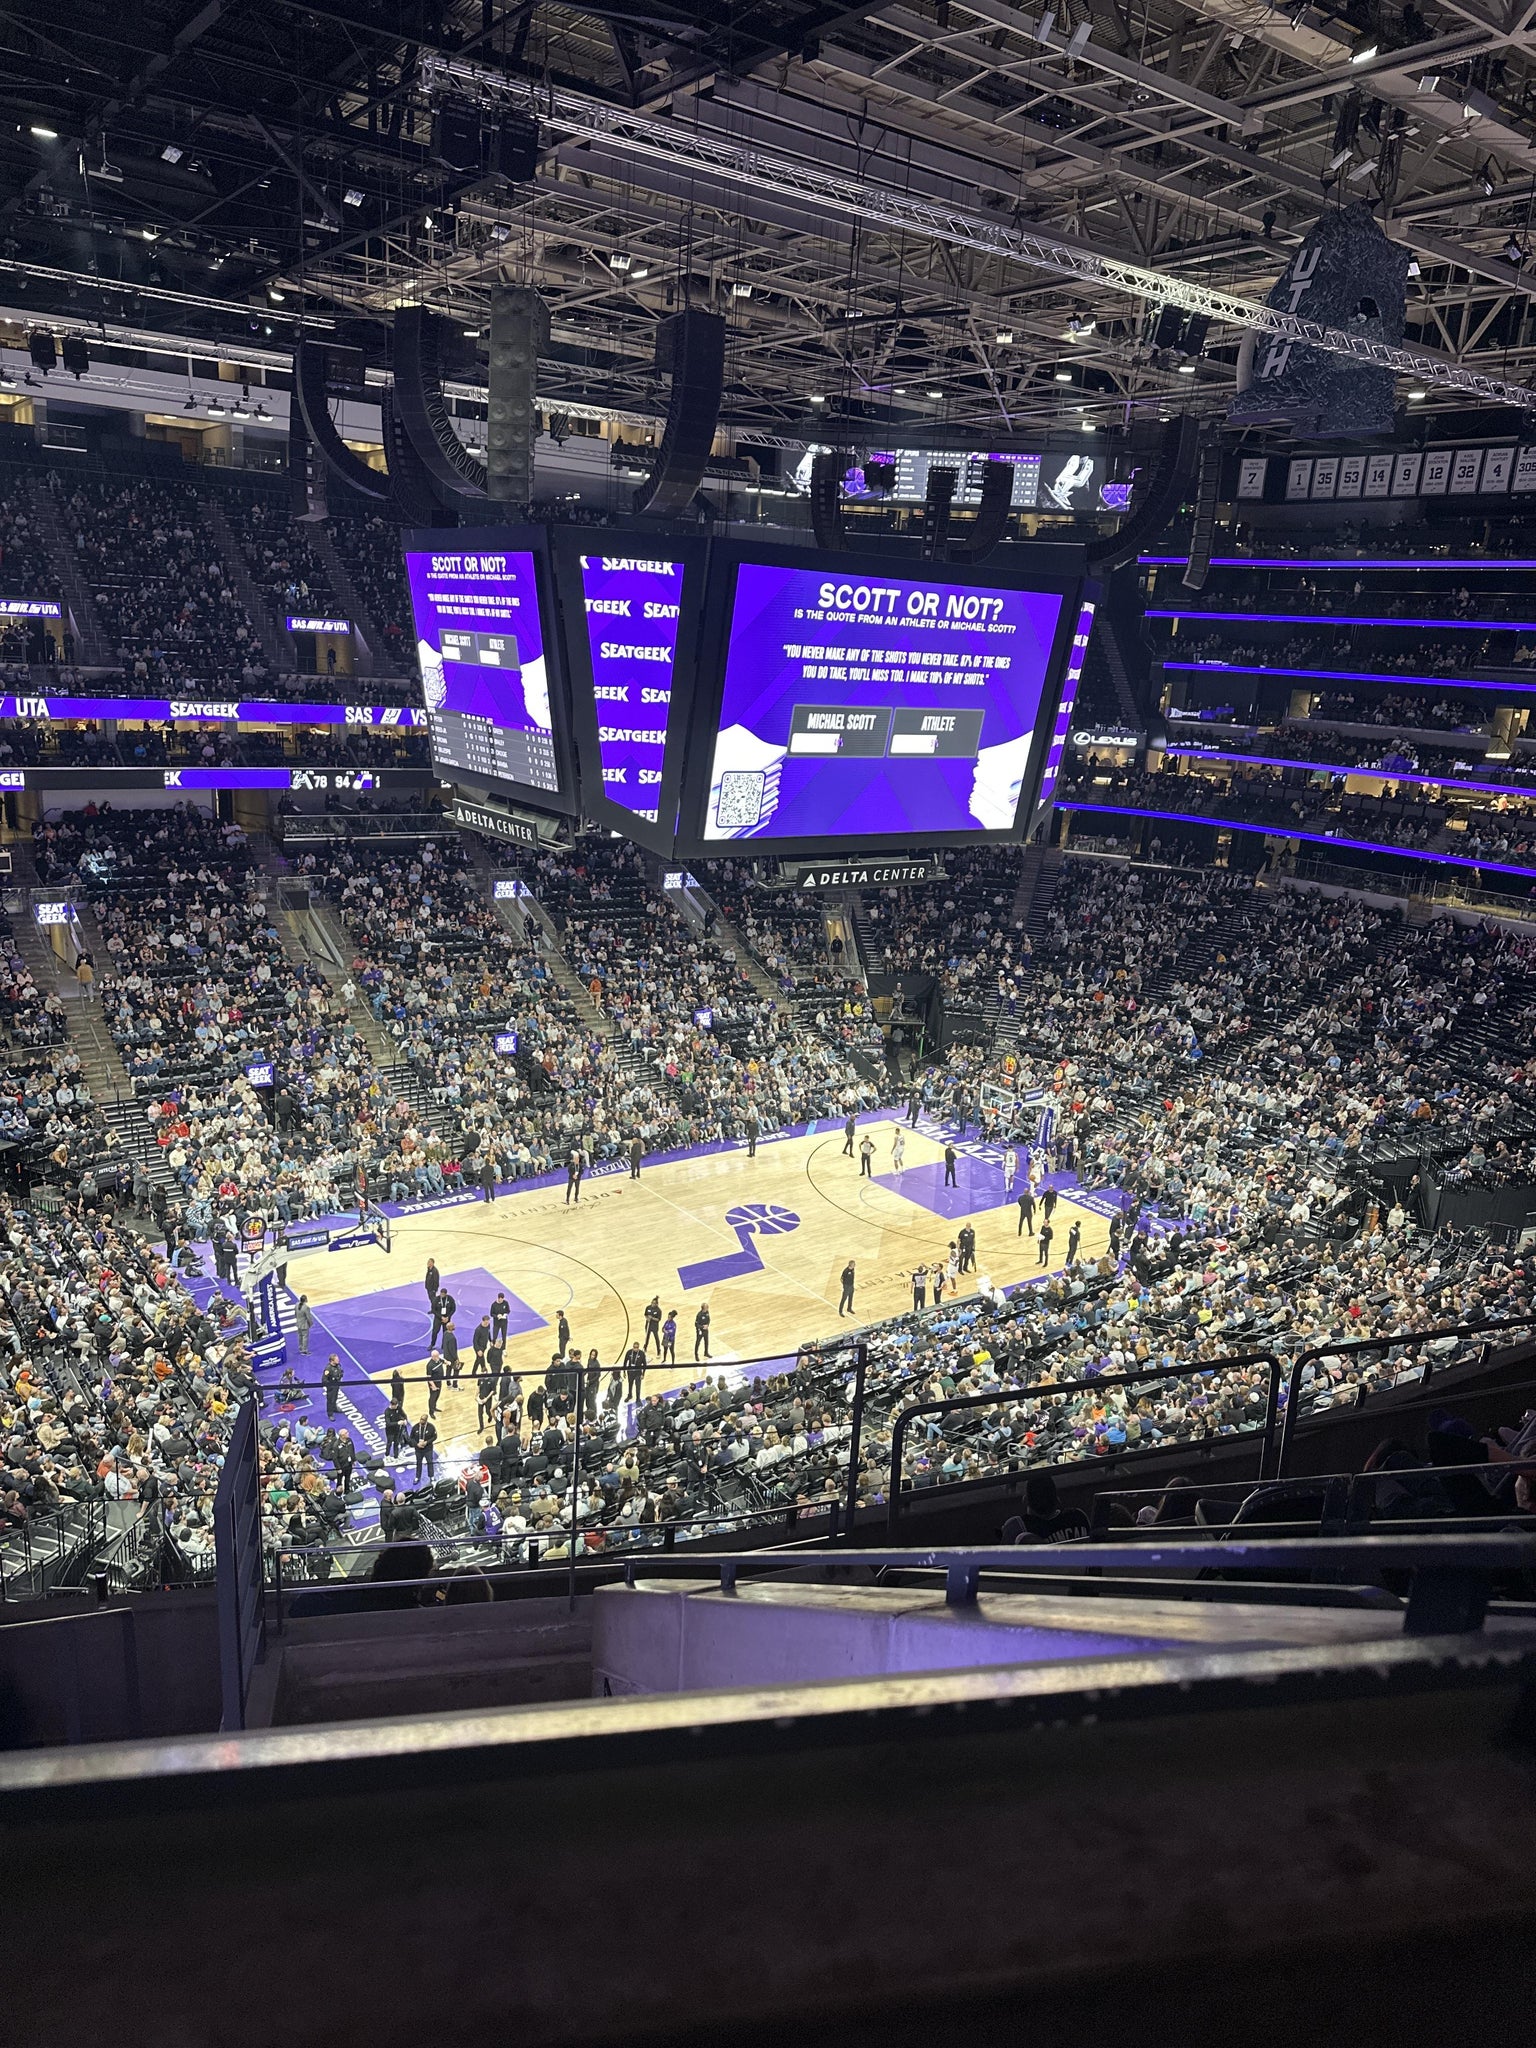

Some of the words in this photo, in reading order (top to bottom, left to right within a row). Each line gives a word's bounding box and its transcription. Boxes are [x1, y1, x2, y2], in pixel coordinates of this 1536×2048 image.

[1343, 471, 1360, 483] 53
[1372, 470, 1385, 482] 14
[1402, 468, 1411, 481] 9
[1429, 467, 1443, 480] 12
[1457, 465, 1475, 478] 32
[1493, 464, 1502, 477] 4
[1247, 472, 1257, 484] 7
[1296, 474, 1302, 485] 1
[1317, 472, 1333, 484] 35
[431, 556, 462, 572] SCOTT
[464, 556, 479, 572] OR
[480, 556, 506, 573] NOT?
[601, 556, 675, 576] SEATGEEK
[818, 582, 901, 613] SCOTT
[907, 591, 940, 616] OR
[945, 594, 1004, 621] NOT?
[41, 604, 59, 615] UTA
[291, 619, 306, 629] SAS
[334, 622, 348, 631] UTA
[794, 608, 804, 619] IS
[806, 609, 825, 620] THE
[826, 611, 856, 623] QUOTE
[857, 614, 883, 625] FROM
[884, 616, 898, 626] AN
[899, 617, 936, 629] ATHLETE
[937, 620, 949, 629] OR
[951, 621, 986, 632] MICHAEL
[987, 623, 1017, 634] SCOTT?
[600, 641, 672, 663] SEATGEEK
[802, 645, 825, 660] NEVER
[825, 646, 845, 660] MAKE
[846, 647, 861, 662] ANY
[860, 648, 871, 662] OF
[871, 649, 884, 663] THE
[885, 650, 907, 664] SHOTS
[908, 652, 921, 665] YOU
[921, 653, 942, 666] NEVER
[973, 655, 982, 668] OF
[982, 656, 994, 668] THE
[994, 656, 1011, 669] ONES
[803, 665, 817, 678] YOU
[817, 666, 829, 679] DO
[830, 666, 848, 682] TAKE,
[849, 667, 871, 681] YOU'LL
[871, 668, 890, 682] MISS
[891, 669, 905, 682] TOO.
[910, 671, 929, 684] MAKE
[943, 672, 953, 684] OF
[953, 673, 964, 685] MY
[15, 698, 50, 717] UTA
[169, 701, 240, 719] SEATGEEK
[345, 706, 373, 724] SAS
[410, 709, 428, 725] VS
[807, 713, 845, 730] MICHAEL
[847, 714, 877, 730] SCOTT
[920, 715, 956, 732] ATHLETE
[598, 726, 667, 745] SEATGEEK
[1091, 735, 1138, 746] LEXUS
[312, 775, 328, 788] 78
[335, 775, 351, 788] 94
[464, 809, 495, 830] DELTA
[496, 819, 533, 842] CENTER
[820, 870, 869, 886] DELTA
[873, 867, 926, 881] CENTER
[38, 903, 65, 914] SEAT
[37, 913, 68, 924] GEEK
[497, 1036, 515, 1044] SEAT
[248, 1066, 270, 1077] SEAT
[397, 1192, 477, 1214] SEATGEEK
